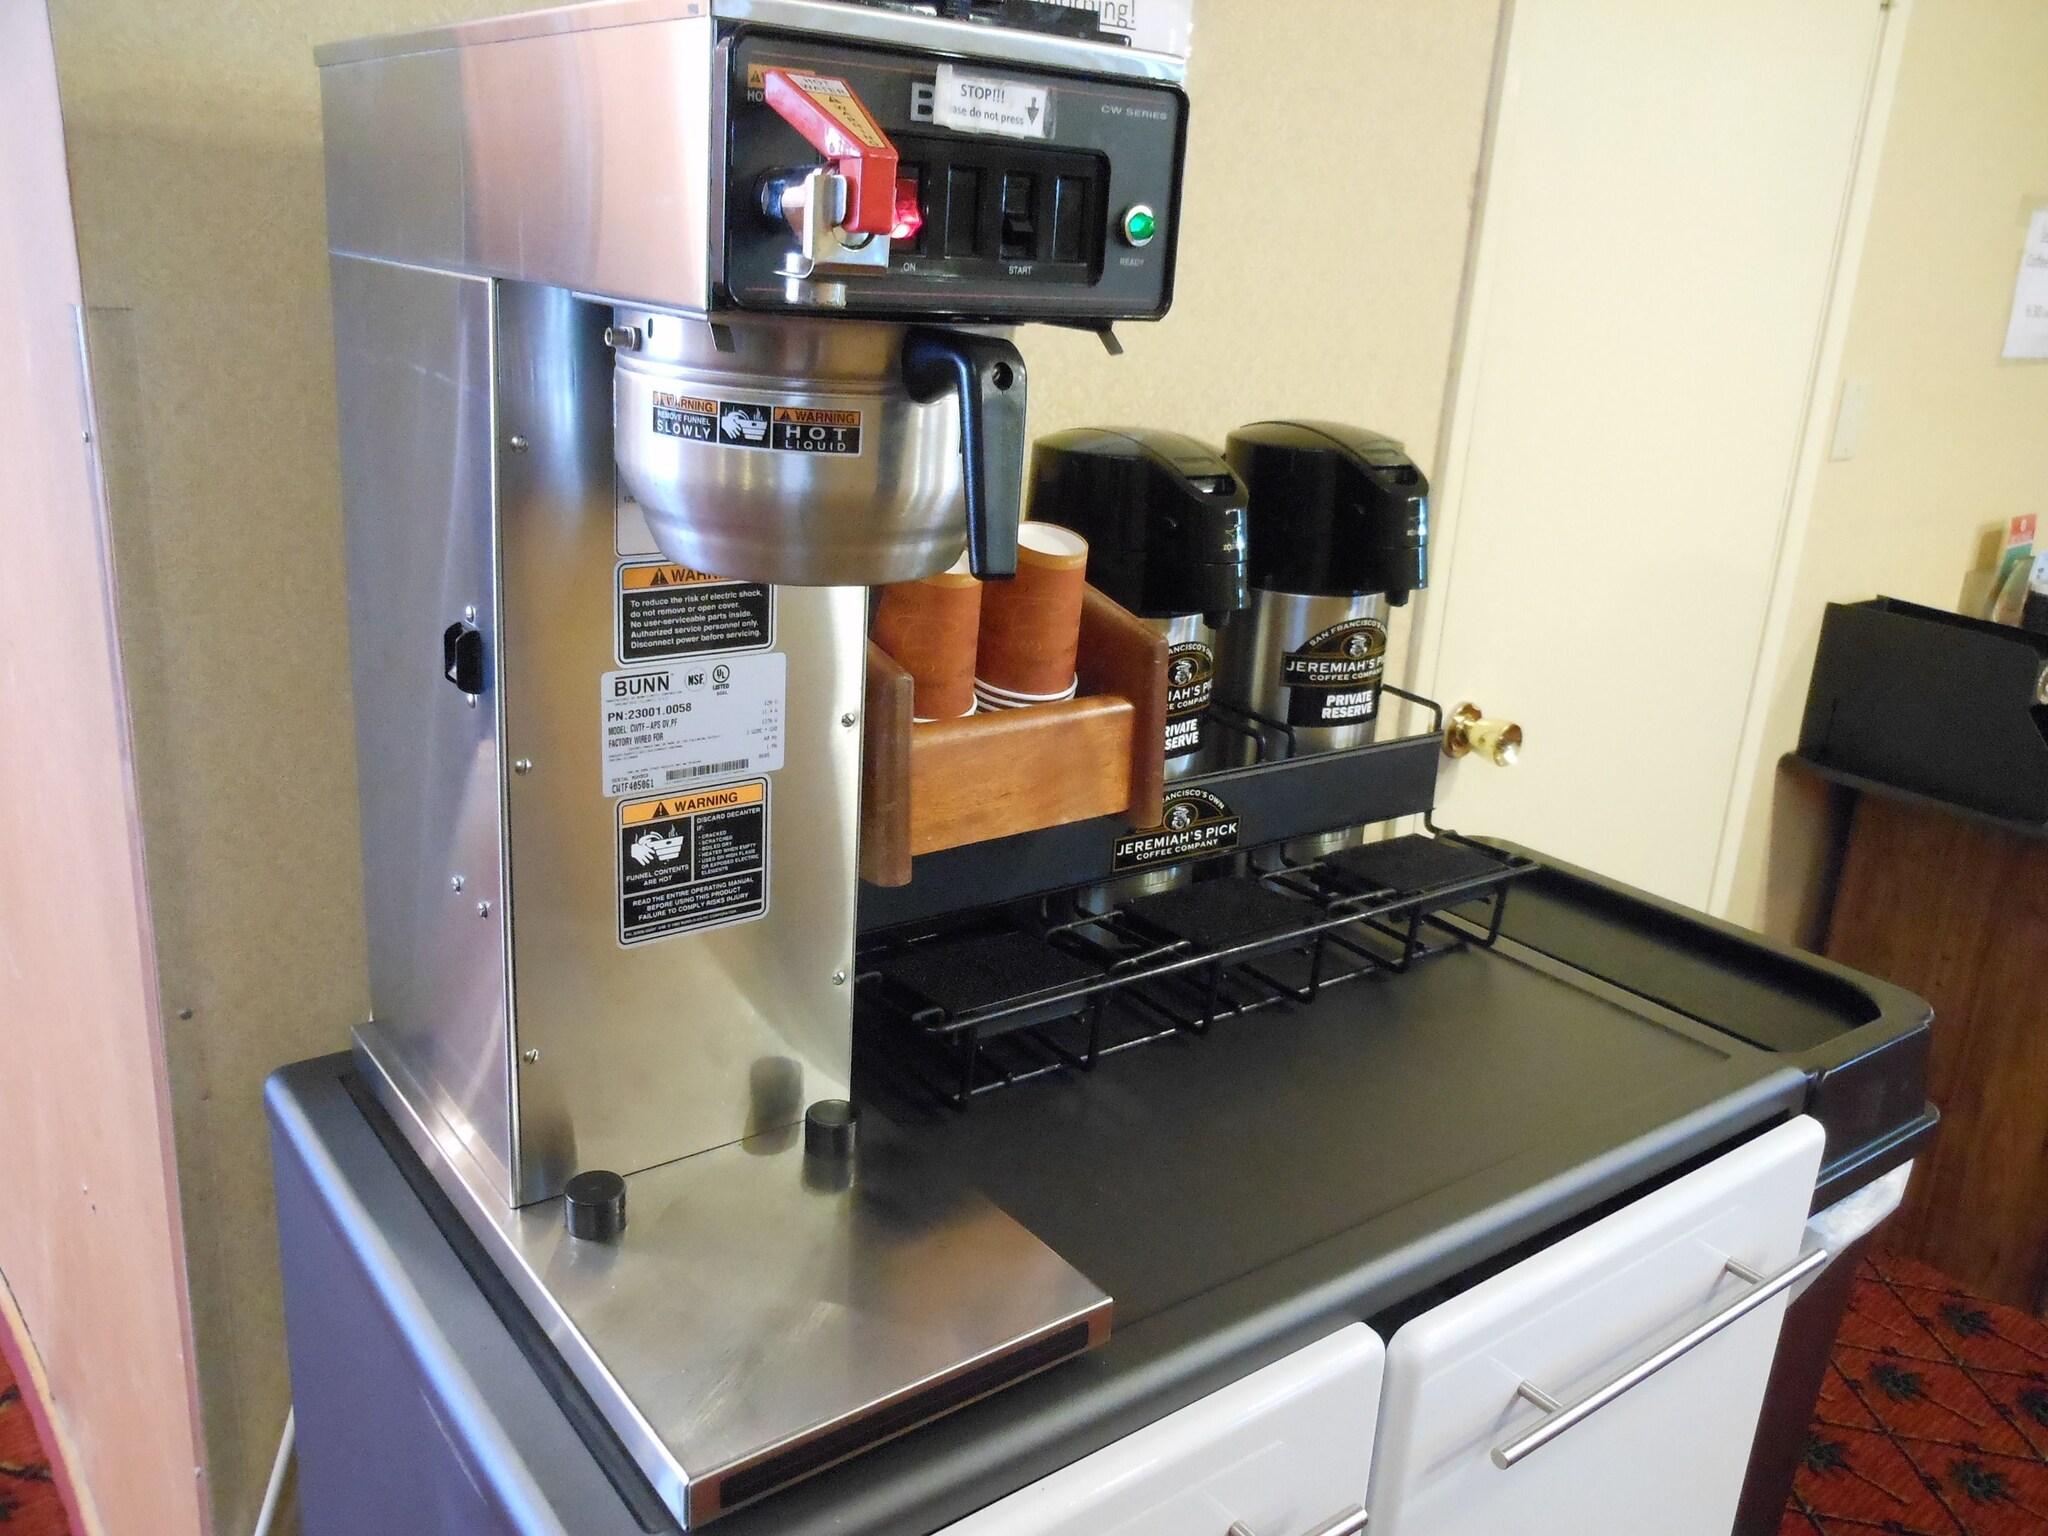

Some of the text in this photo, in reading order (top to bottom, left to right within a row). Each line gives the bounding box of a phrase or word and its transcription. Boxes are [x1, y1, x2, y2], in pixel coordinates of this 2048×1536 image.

[747, 90, 765, 102] HO
[960, 84, 1005, 103] STOP!!!
[969, 107, 981, 118] do
[984, 110, 999, 121] not
[1000, 115, 1024, 126] press
[1101, 104, 1167, 120] CW SERIES
[903, 262, 916, 273] ON
[1119, 257, 1145, 266] READY
[1008, 265, 1032, 276] START
[684, 414, 711, 425] FUNNEL
[795, 411, 855, 425] WARNING
[657, 420, 711, 439] SLOWLY
[785, 425, 847, 441] HOT
[785, 440, 846, 452] LIQUID
[630, 600, 641, 608] To
[642, 599, 669, 607] reduce
[670, 596, 683, 604] the
[700, 593, 709, 601] of
[710, 592, 737, 600] electric
[630, 610, 641, 618] do
[642, 609, 656, 617] not
[657, 607, 686, 615] remove
[697, 604, 716, 612] open
[630, 621, 642, 629] No
[643, 615, 706, 627] user-serviceable
[707, 613, 727, 622] parts
[630, 627, 673, 638] Authorized
[674, 626, 702, 634] service
[703, 621, 740, 632] personnel
[630, 638, 674, 649] Disconnect
[675, 636, 699, 645] power
[700, 633, 725, 641] before
[1309, 631, 1330, 646] SAN
[716, 669, 726, 679] UL
[1286, 659, 1375, 673] JEREMIAH'S
[1309, 673, 1350, 681] COFFEE
[614, 674, 670, 697] BUNN
[1168, 685, 1201, 702] IAH'S
[1177, 693, 1210, 709] COMPANY
[1326, 690, 1373, 706] PRIVATE
[607, 702, 692, 722] PN:23001.0058
[1321, 702, 1373, 719] RESERVE
[1164, 719, 1198, 737] RIVATE
[608, 737, 633, 748] FACTORY
[634, 734, 652, 744] WIRED
[653, 732, 664, 742] FOR
[1164, 731, 1200, 751] SERVE
[675, 792, 738, 812] WARNING
[1162, 788, 1225, 810] ANCISCO'S OWN
[696, 807, 761, 823] DISCARD DECANTER
[1116, 822, 1238, 856] JEREMIAH'S PICK
[1136, 838, 1218, 861] COFFEE COMPANY
[626, 864, 689, 881] FUNNEL CONTENTS
[643, 875, 673, 886] ARE HOT
[632, 877, 754, 907] READ THE ENTIRE OPERATING MANUAL
[646, 886, 741, 911] BEFORE USING THIS PRODUCT
[638, 909, 667, 921] FAILURE
[678, 902, 706, 912] COMPLY
[706, 897, 726, 906] RISKS
